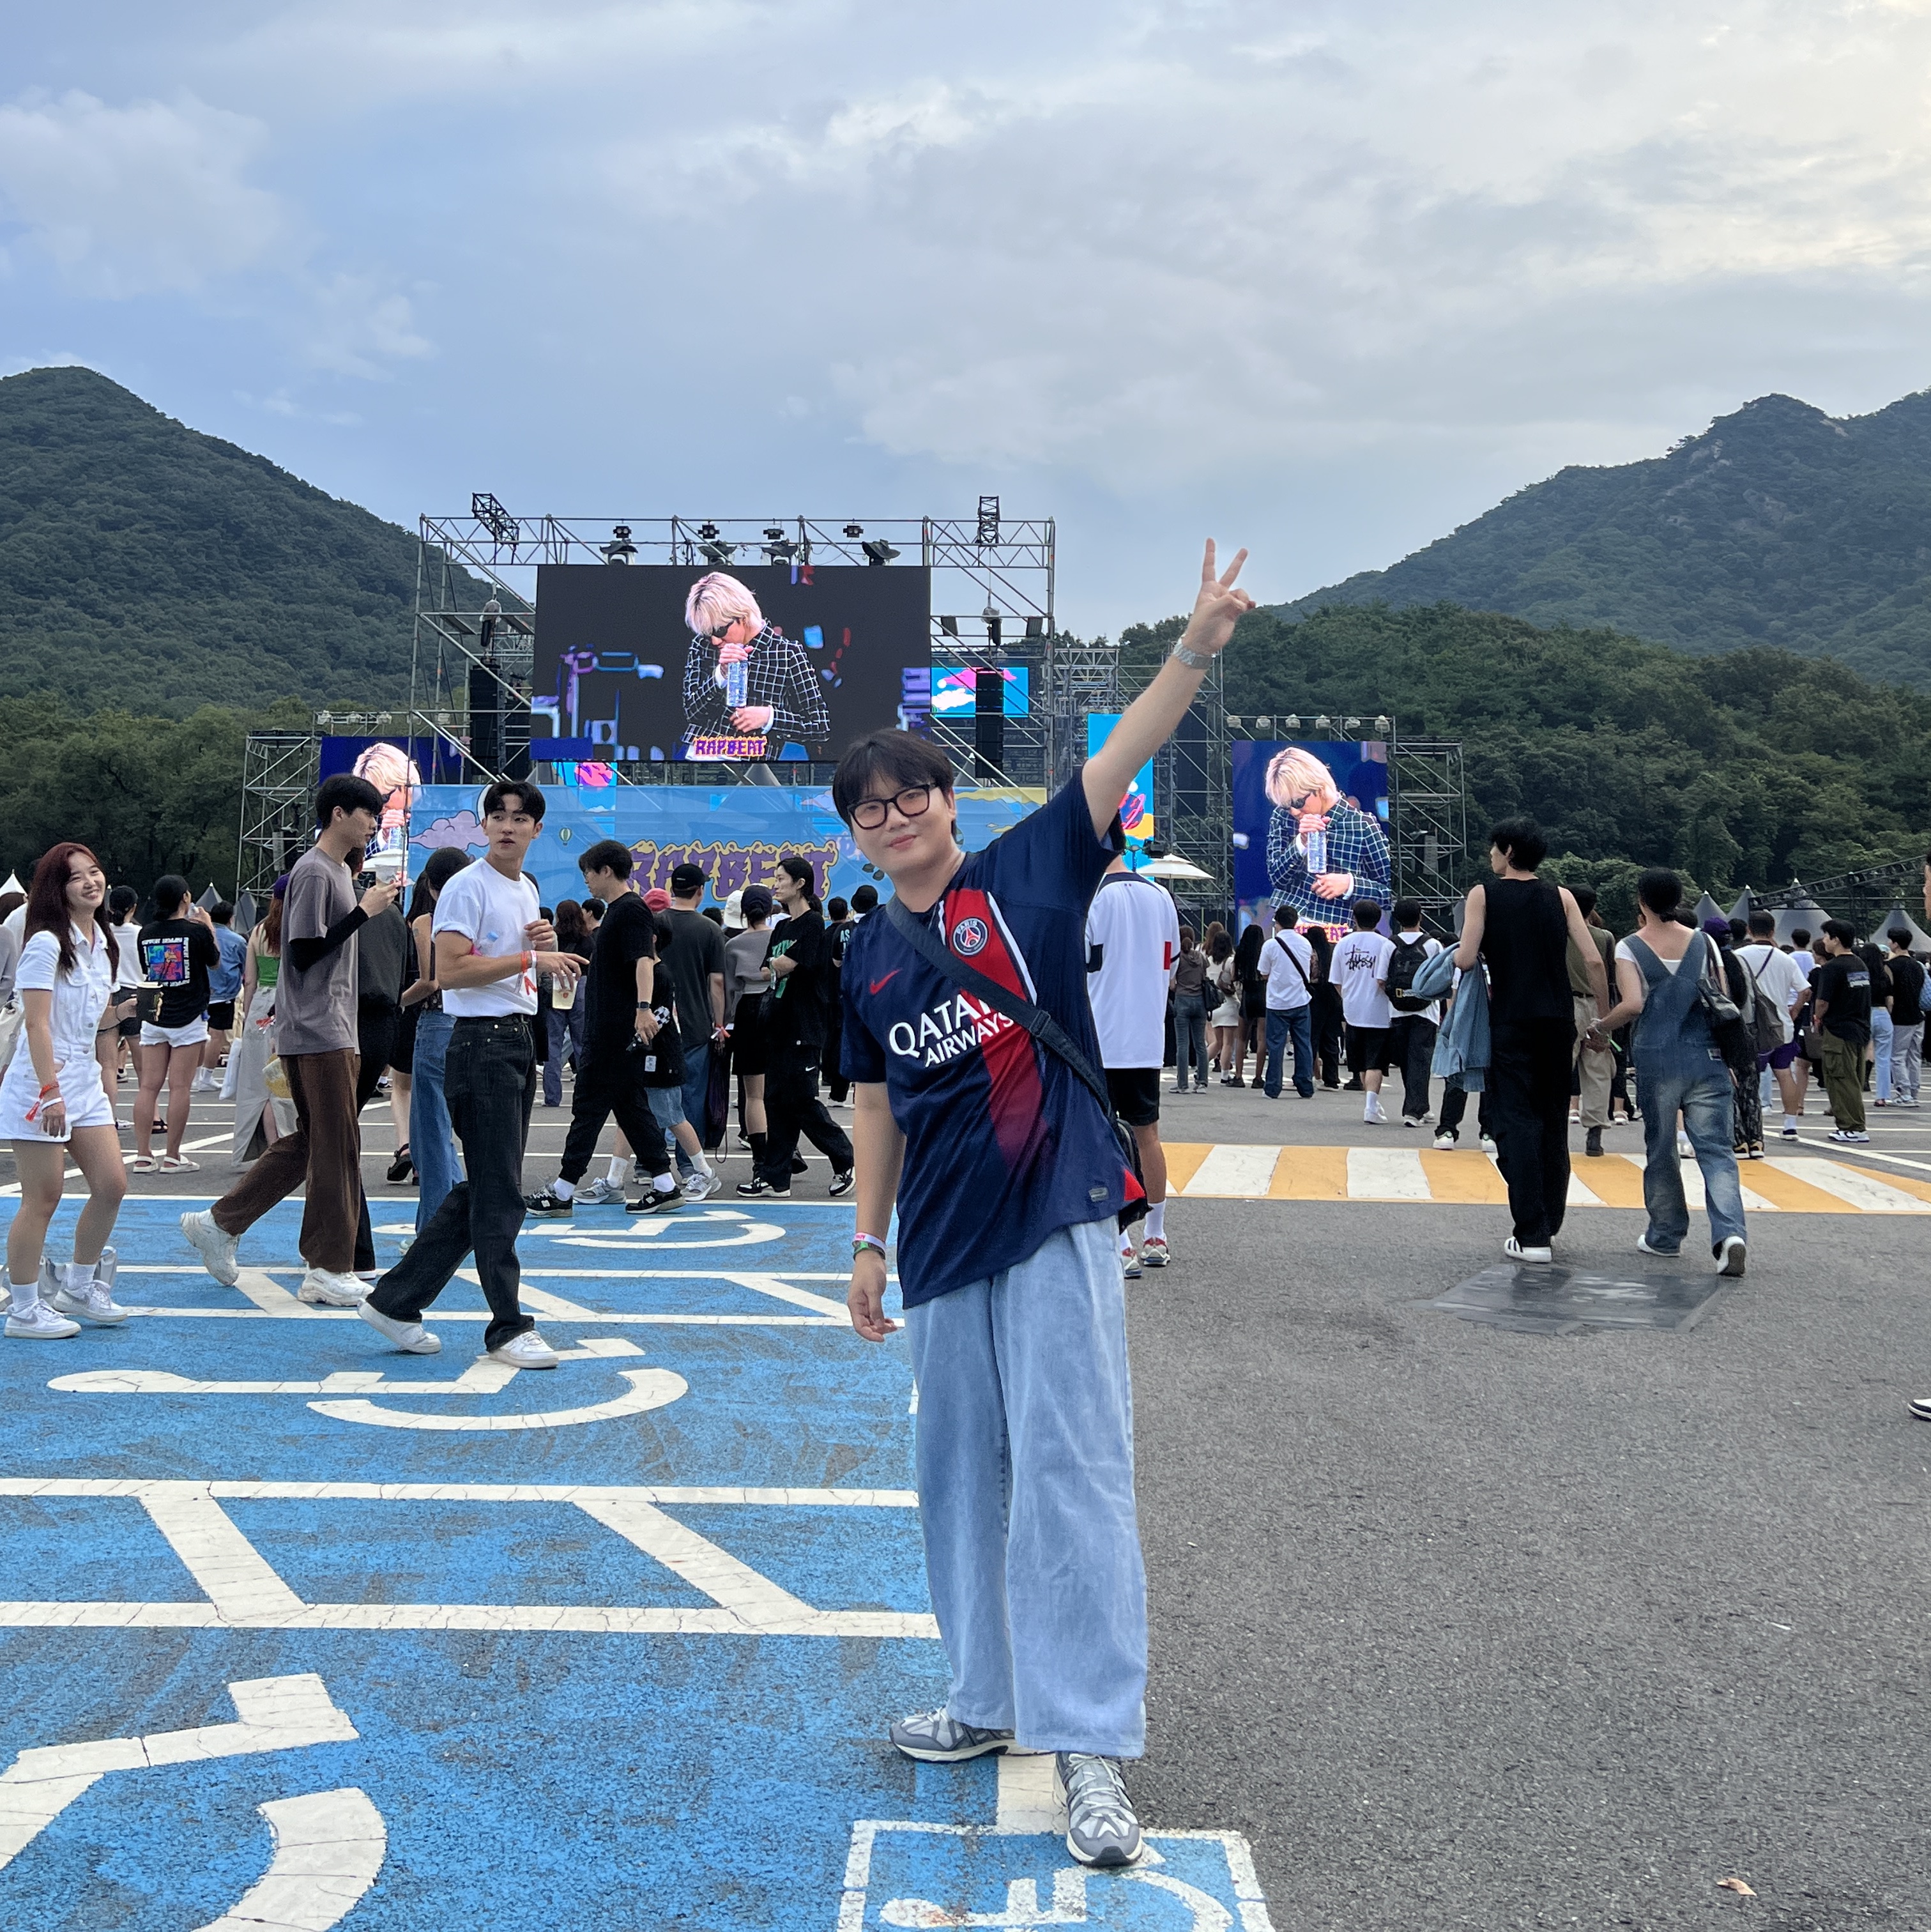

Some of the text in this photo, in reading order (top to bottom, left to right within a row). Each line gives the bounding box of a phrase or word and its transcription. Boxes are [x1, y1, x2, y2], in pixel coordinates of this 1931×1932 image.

[694, 737, 767, 756] RAPBEAT
[627, 842, 837, 900] RAPBET
[956, 920, 978, 935] PARIS
[925, 1012, 1014, 1068] AIRWAYS
